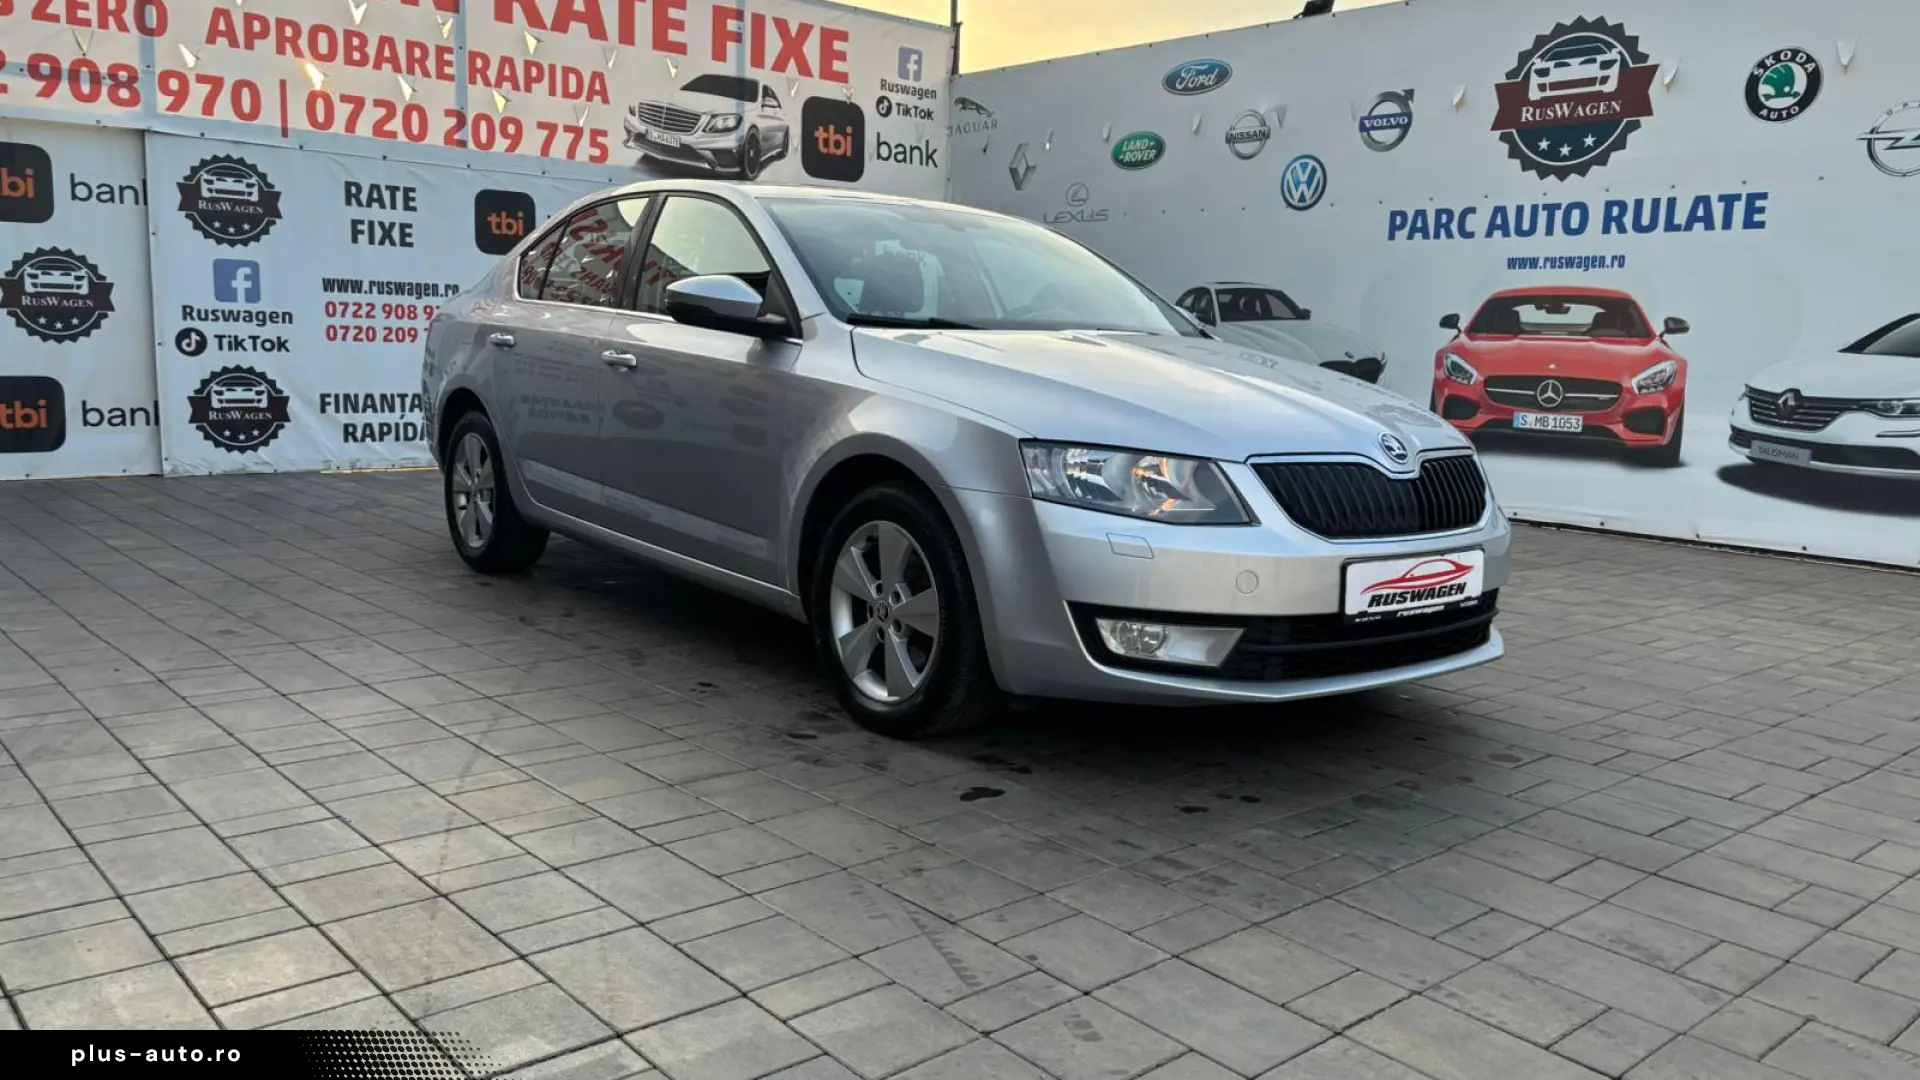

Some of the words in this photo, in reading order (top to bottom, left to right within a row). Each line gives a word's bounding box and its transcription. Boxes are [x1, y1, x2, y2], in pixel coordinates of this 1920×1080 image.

[31, 0, 168, 38] ZERO
[205, 6, 456, 82] APROBARE
[468, 51, 611, 105] RAPIDA
[711, 4, 849, 84] FIXE
[1175, 64, 1218, 90] Ford
[880, 78, 938, 100] Ruswagen
[27, 52, 141, 108] 908
[157, 69, 262, 122] 970
[306, 89, 429, 143] 0720
[443, 109, 524, 153] 209
[536, 121, 610, 164] 775
[895, 102, 934, 121] TikTok
[1758, 105, 1800, 119] AUTO
[946, 118, 999, 138] JAGUAR
[1363, 116, 1409, 128] VOLVO
[814, 124, 853, 157] tbi
[876, 131, 939, 168] bank
[1229, 129, 1267, 141] NISSAN
[343, 180, 418, 212] RATE
[487, 210, 525, 236] tbi
[1043, 208, 1111, 224] LEXUS
[1387, 206, 1478, 241] PARC
[1484, 201, 1590, 238] AUTO
[1601, 191, 1769, 235] RULATE
[351, 219, 415, 248] FIXE
[1506, 254, 1626, 272] www.ruswagen.ro
[181, 304, 294, 327] Ruswagen
[324, 300, 377, 319] 0722
[381, 303, 419, 320] 908
[213, 334, 291, 353] TikTok
[325, 324, 378, 342] 0720
[382, 326, 419, 343] 209
[1367, 582, 1467, 608] RUSWAGEN
